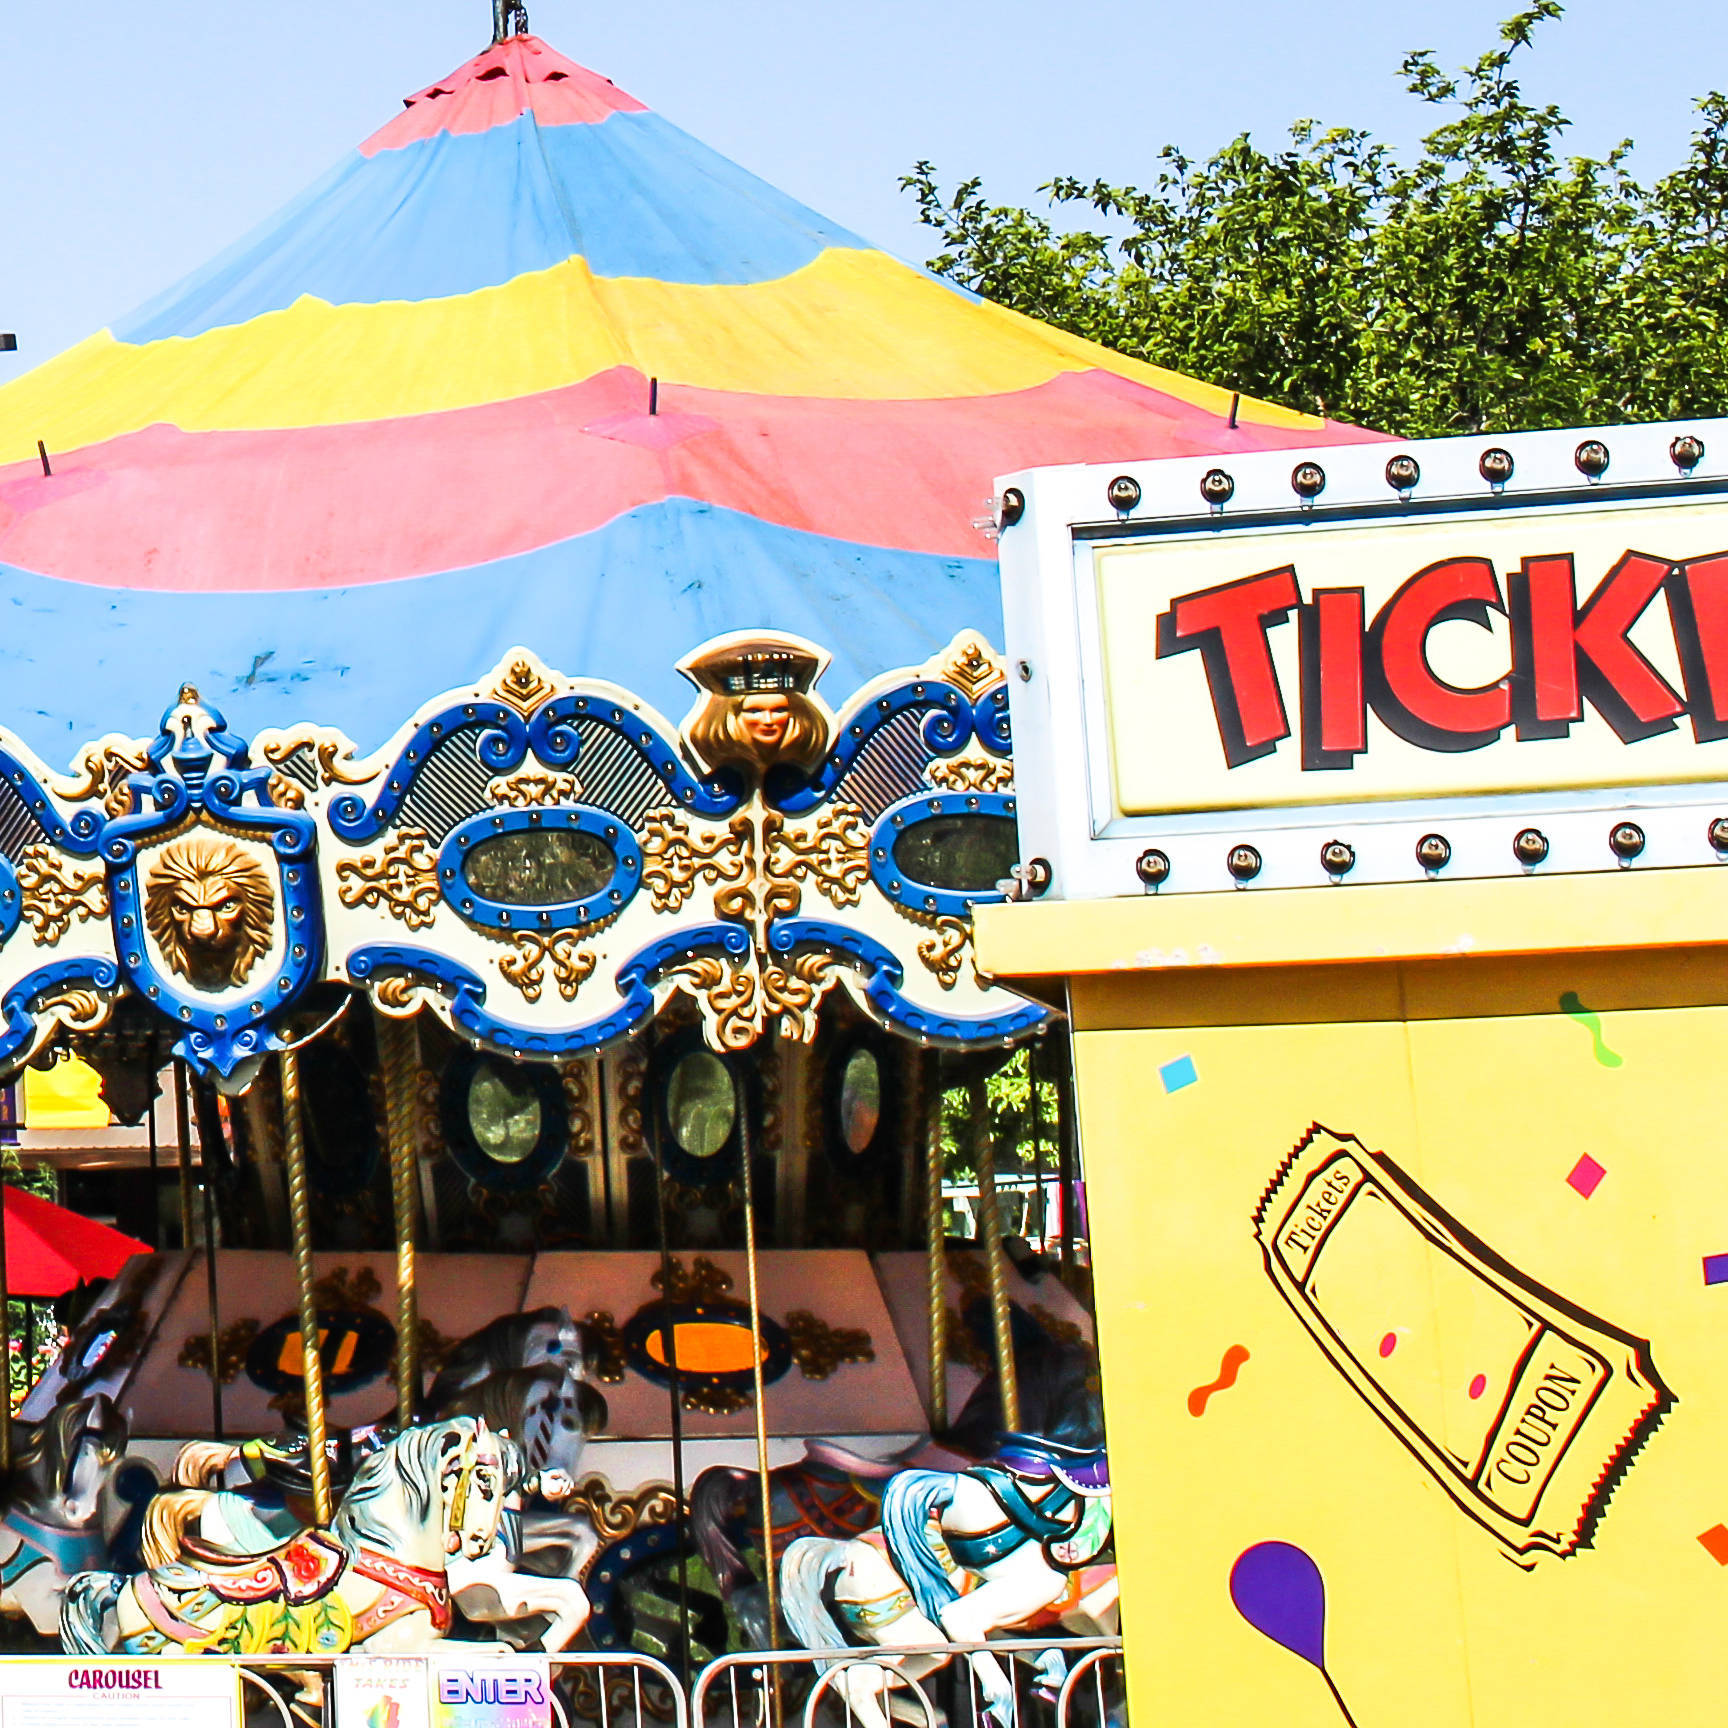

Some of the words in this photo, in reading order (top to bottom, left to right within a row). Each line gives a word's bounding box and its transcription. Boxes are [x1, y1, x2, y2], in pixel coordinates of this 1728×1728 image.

[1284, 1169, 1351, 1255] Tickets
[1495, 1362, 1583, 1486] COUPON
[67, 1668, 163, 1690] CAROUSEL
[353, 1677, 411, 1689] TAKES
[437, 1668, 545, 1705] ENTER
[92, 1692, 141, 1701] CAUTION
